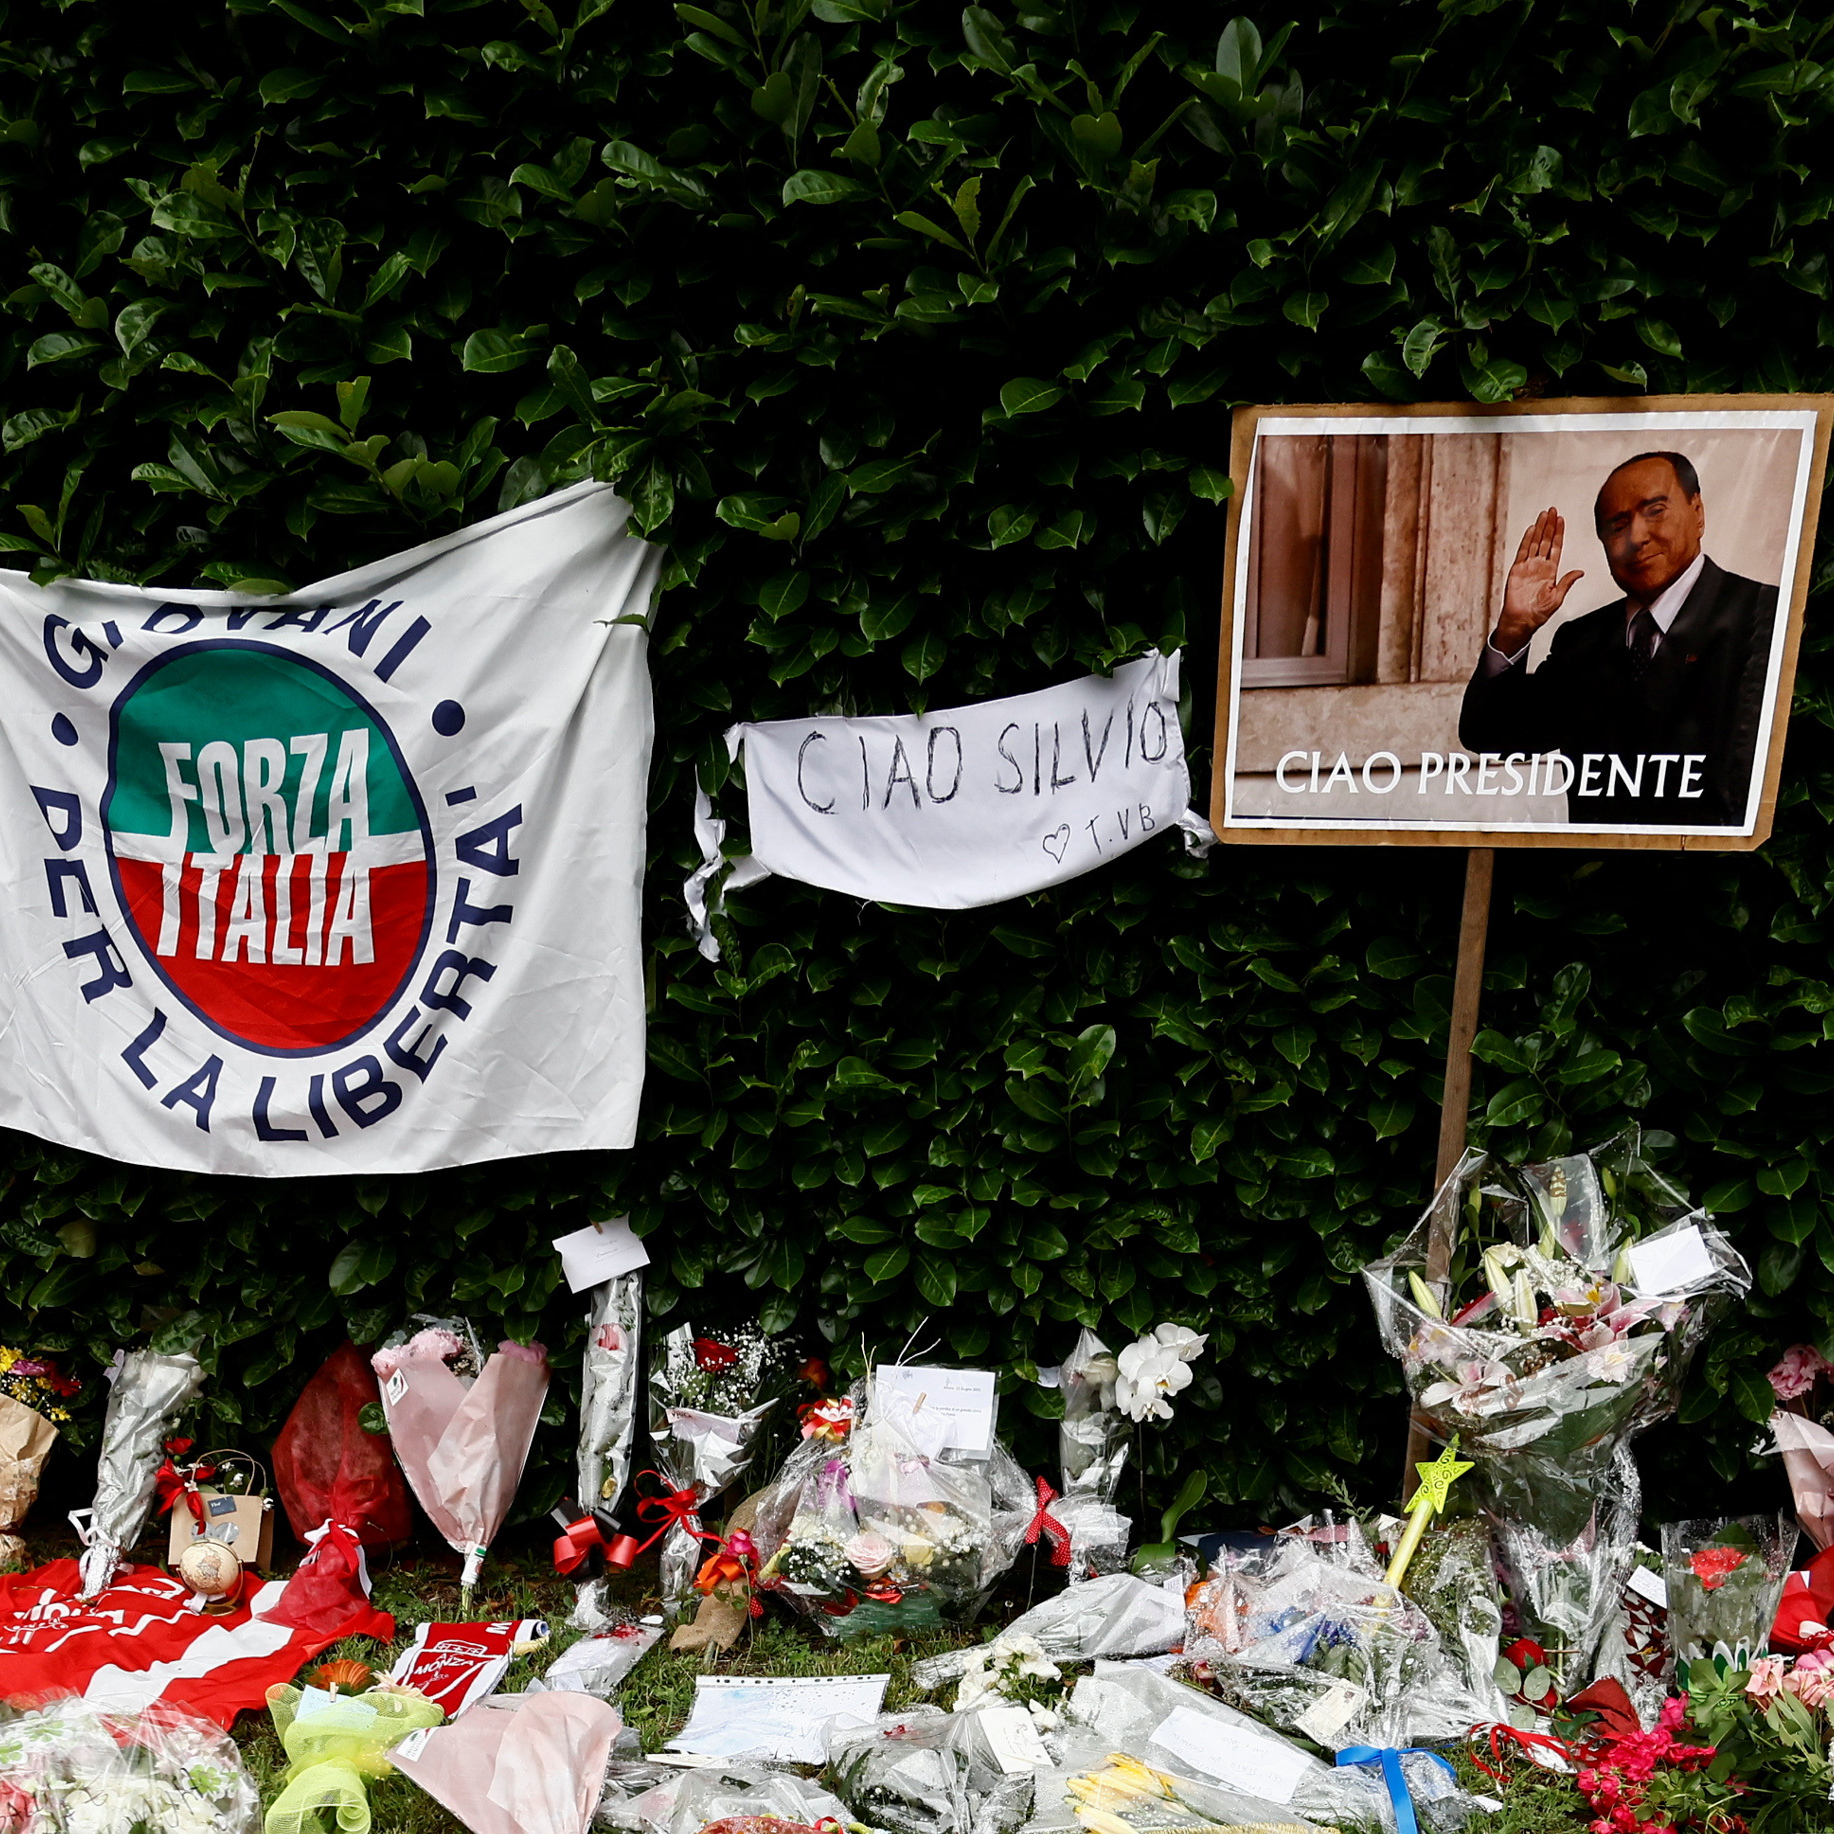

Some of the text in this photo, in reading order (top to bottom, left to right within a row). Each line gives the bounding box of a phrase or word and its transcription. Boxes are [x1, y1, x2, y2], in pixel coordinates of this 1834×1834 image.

[43, 598, 432, 690] GIOVANI
[157, 727, 372, 854] FORZA
[797, 700, 1168, 818] CIAO SILVIO
[1275, 749, 1708, 800] CIAO PRESIDENTE
[29, 784, 135, 1005] PER
[121, 1008, 218, 1134] LA
[157, 851, 375, 967] ITALIA
[414, 1658, 475, 1676] MONZA
